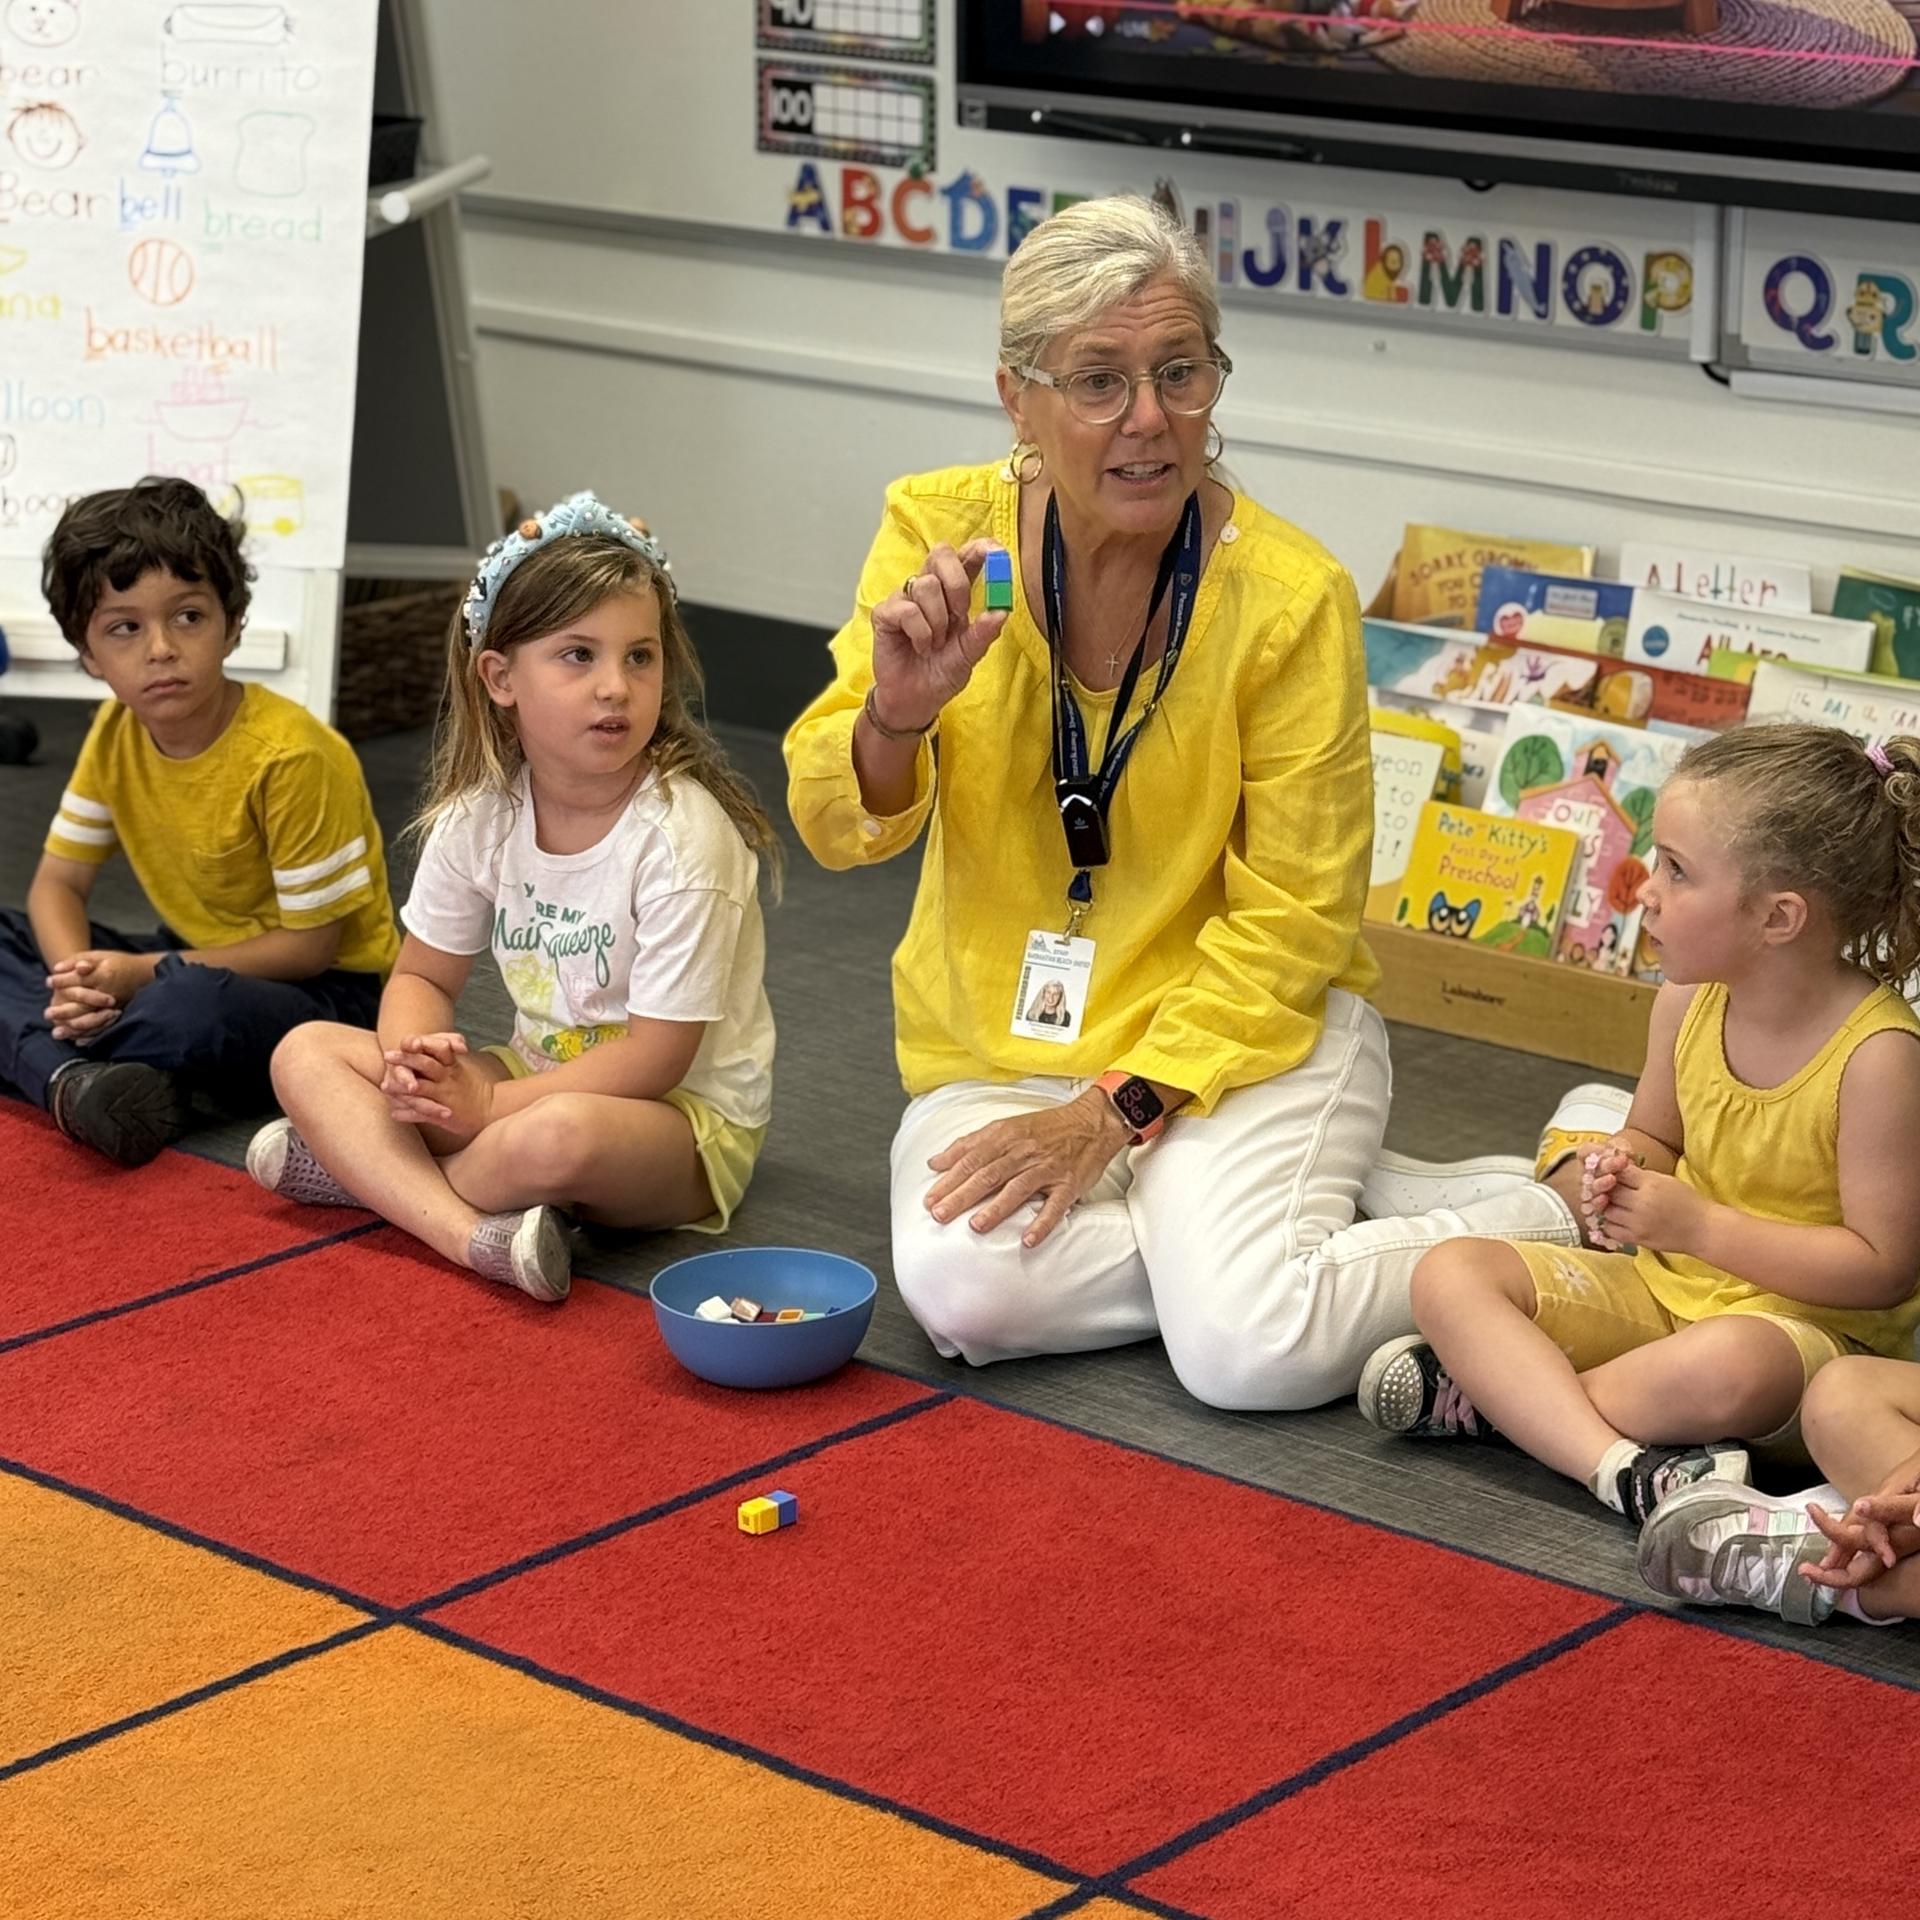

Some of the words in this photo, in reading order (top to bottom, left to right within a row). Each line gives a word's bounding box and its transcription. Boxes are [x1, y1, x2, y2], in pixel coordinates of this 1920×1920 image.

[161, 41, 320, 95] burrito
[769, 86, 812, 127] 100
[0, 171, 110, 218] Bear
[119, 177, 182, 224] bell
[203, 198, 322, 243] bread
[84, 303, 279, 371] basketball
[1390, 785, 1415, 806] to
[1383, 811, 1408, 831] to
[1438, 811, 1474, 838] Pete
[1488, 824, 1549, 859] Kitty's
[1438, 854, 1520, 891] Preschool
[1479, 849, 1501, 867] Day
[561, 906, 587, 925] MY
